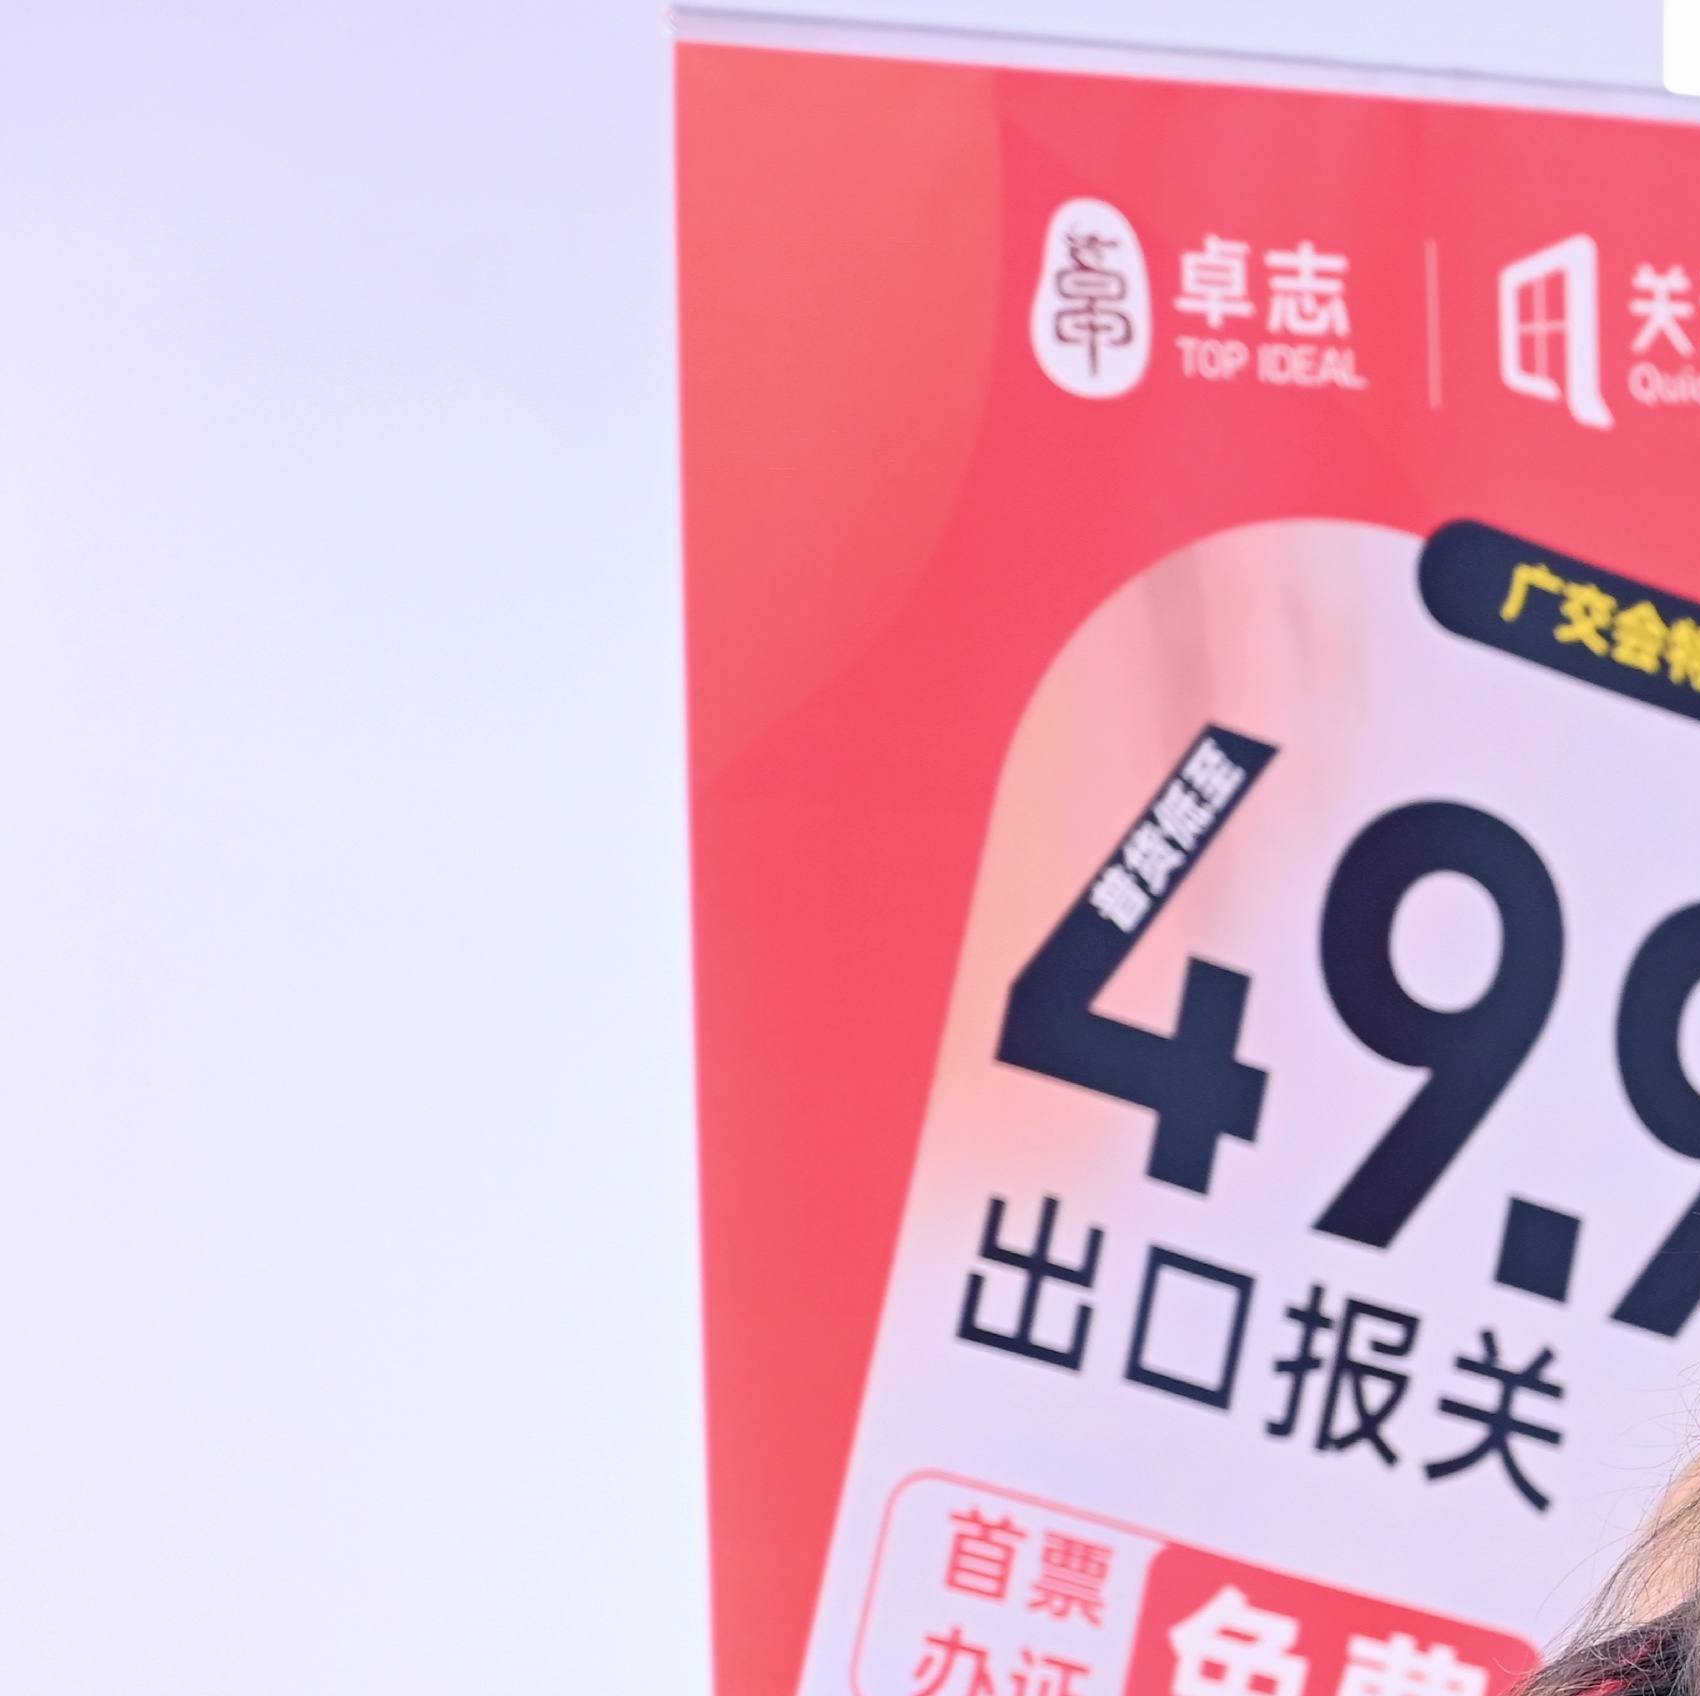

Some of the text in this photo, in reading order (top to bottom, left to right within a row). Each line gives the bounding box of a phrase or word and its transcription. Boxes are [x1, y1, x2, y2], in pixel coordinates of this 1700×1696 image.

[1176, 236, 1350, 336] 卓志
[1175, 336, 1368, 391] TOP IDEAL
[953, 1193, 1567, 1515] 出口报关
[942, 1506, 1115, 1631] 首票
